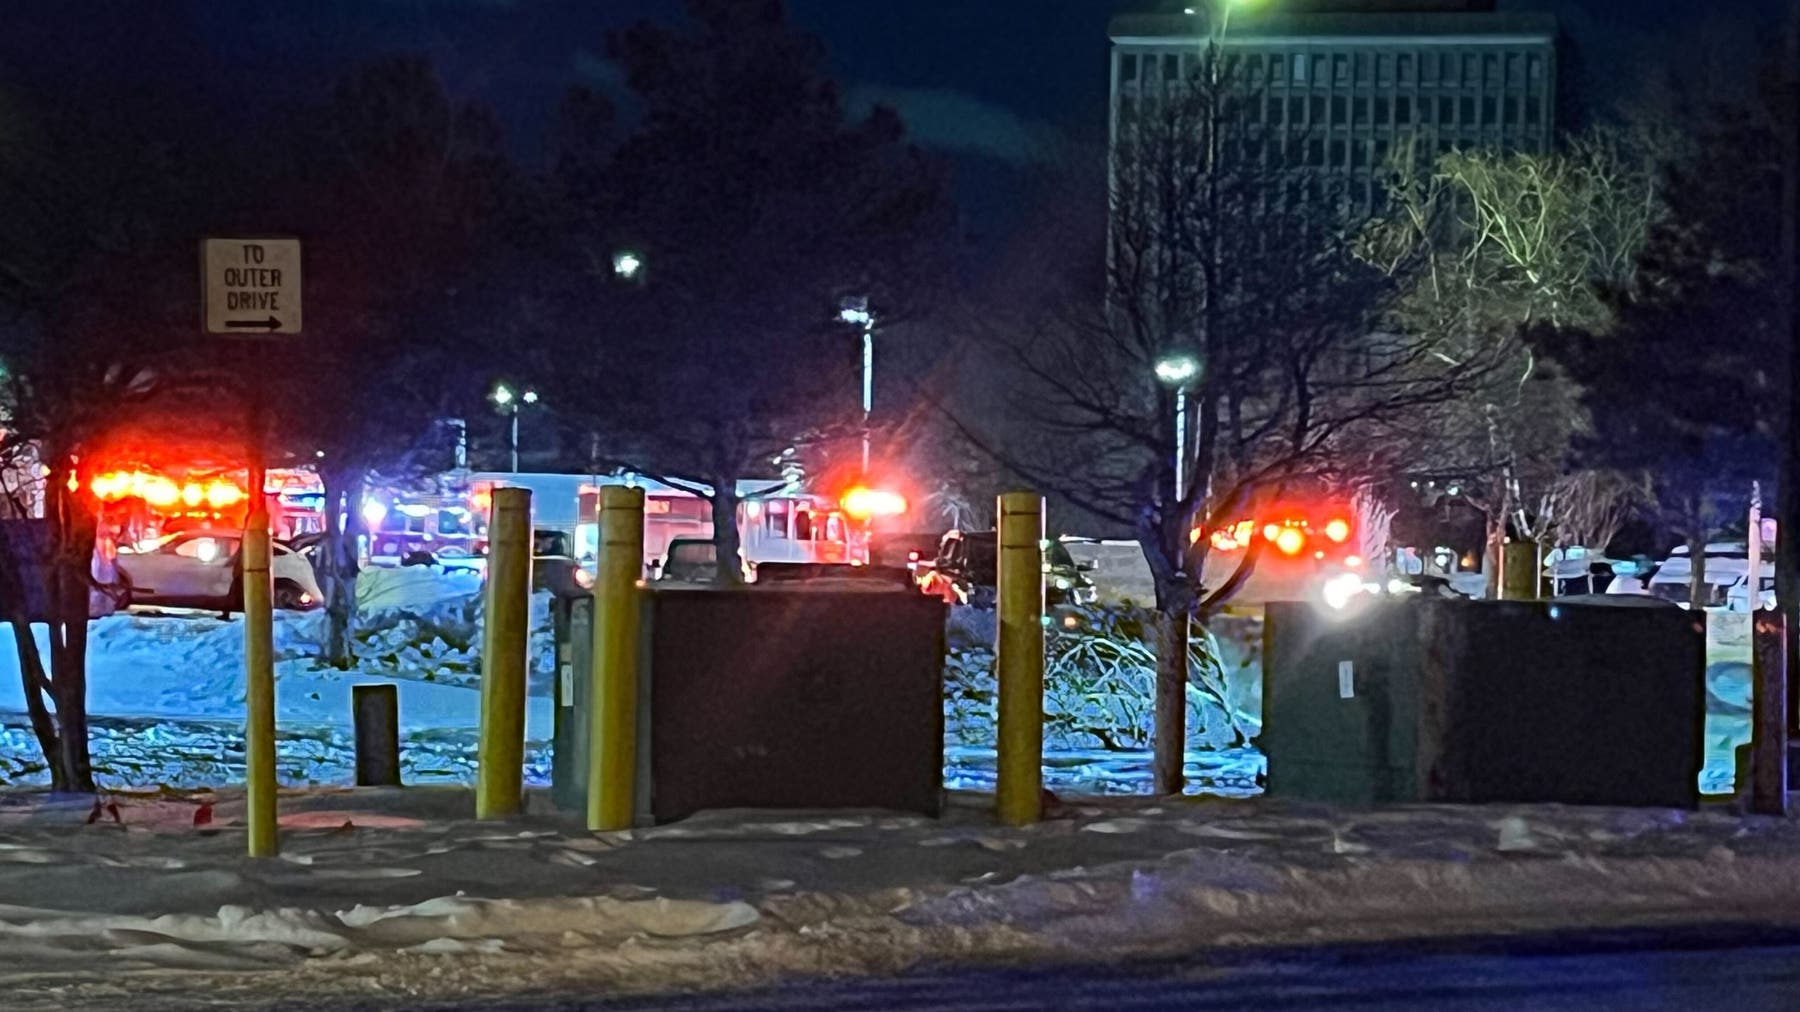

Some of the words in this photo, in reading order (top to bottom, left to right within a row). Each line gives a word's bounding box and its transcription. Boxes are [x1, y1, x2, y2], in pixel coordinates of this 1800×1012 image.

[243, 244, 264, 264] TO
[224, 268, 281, 287] OUTER
[227, 291, 280, 311] DRIVE
